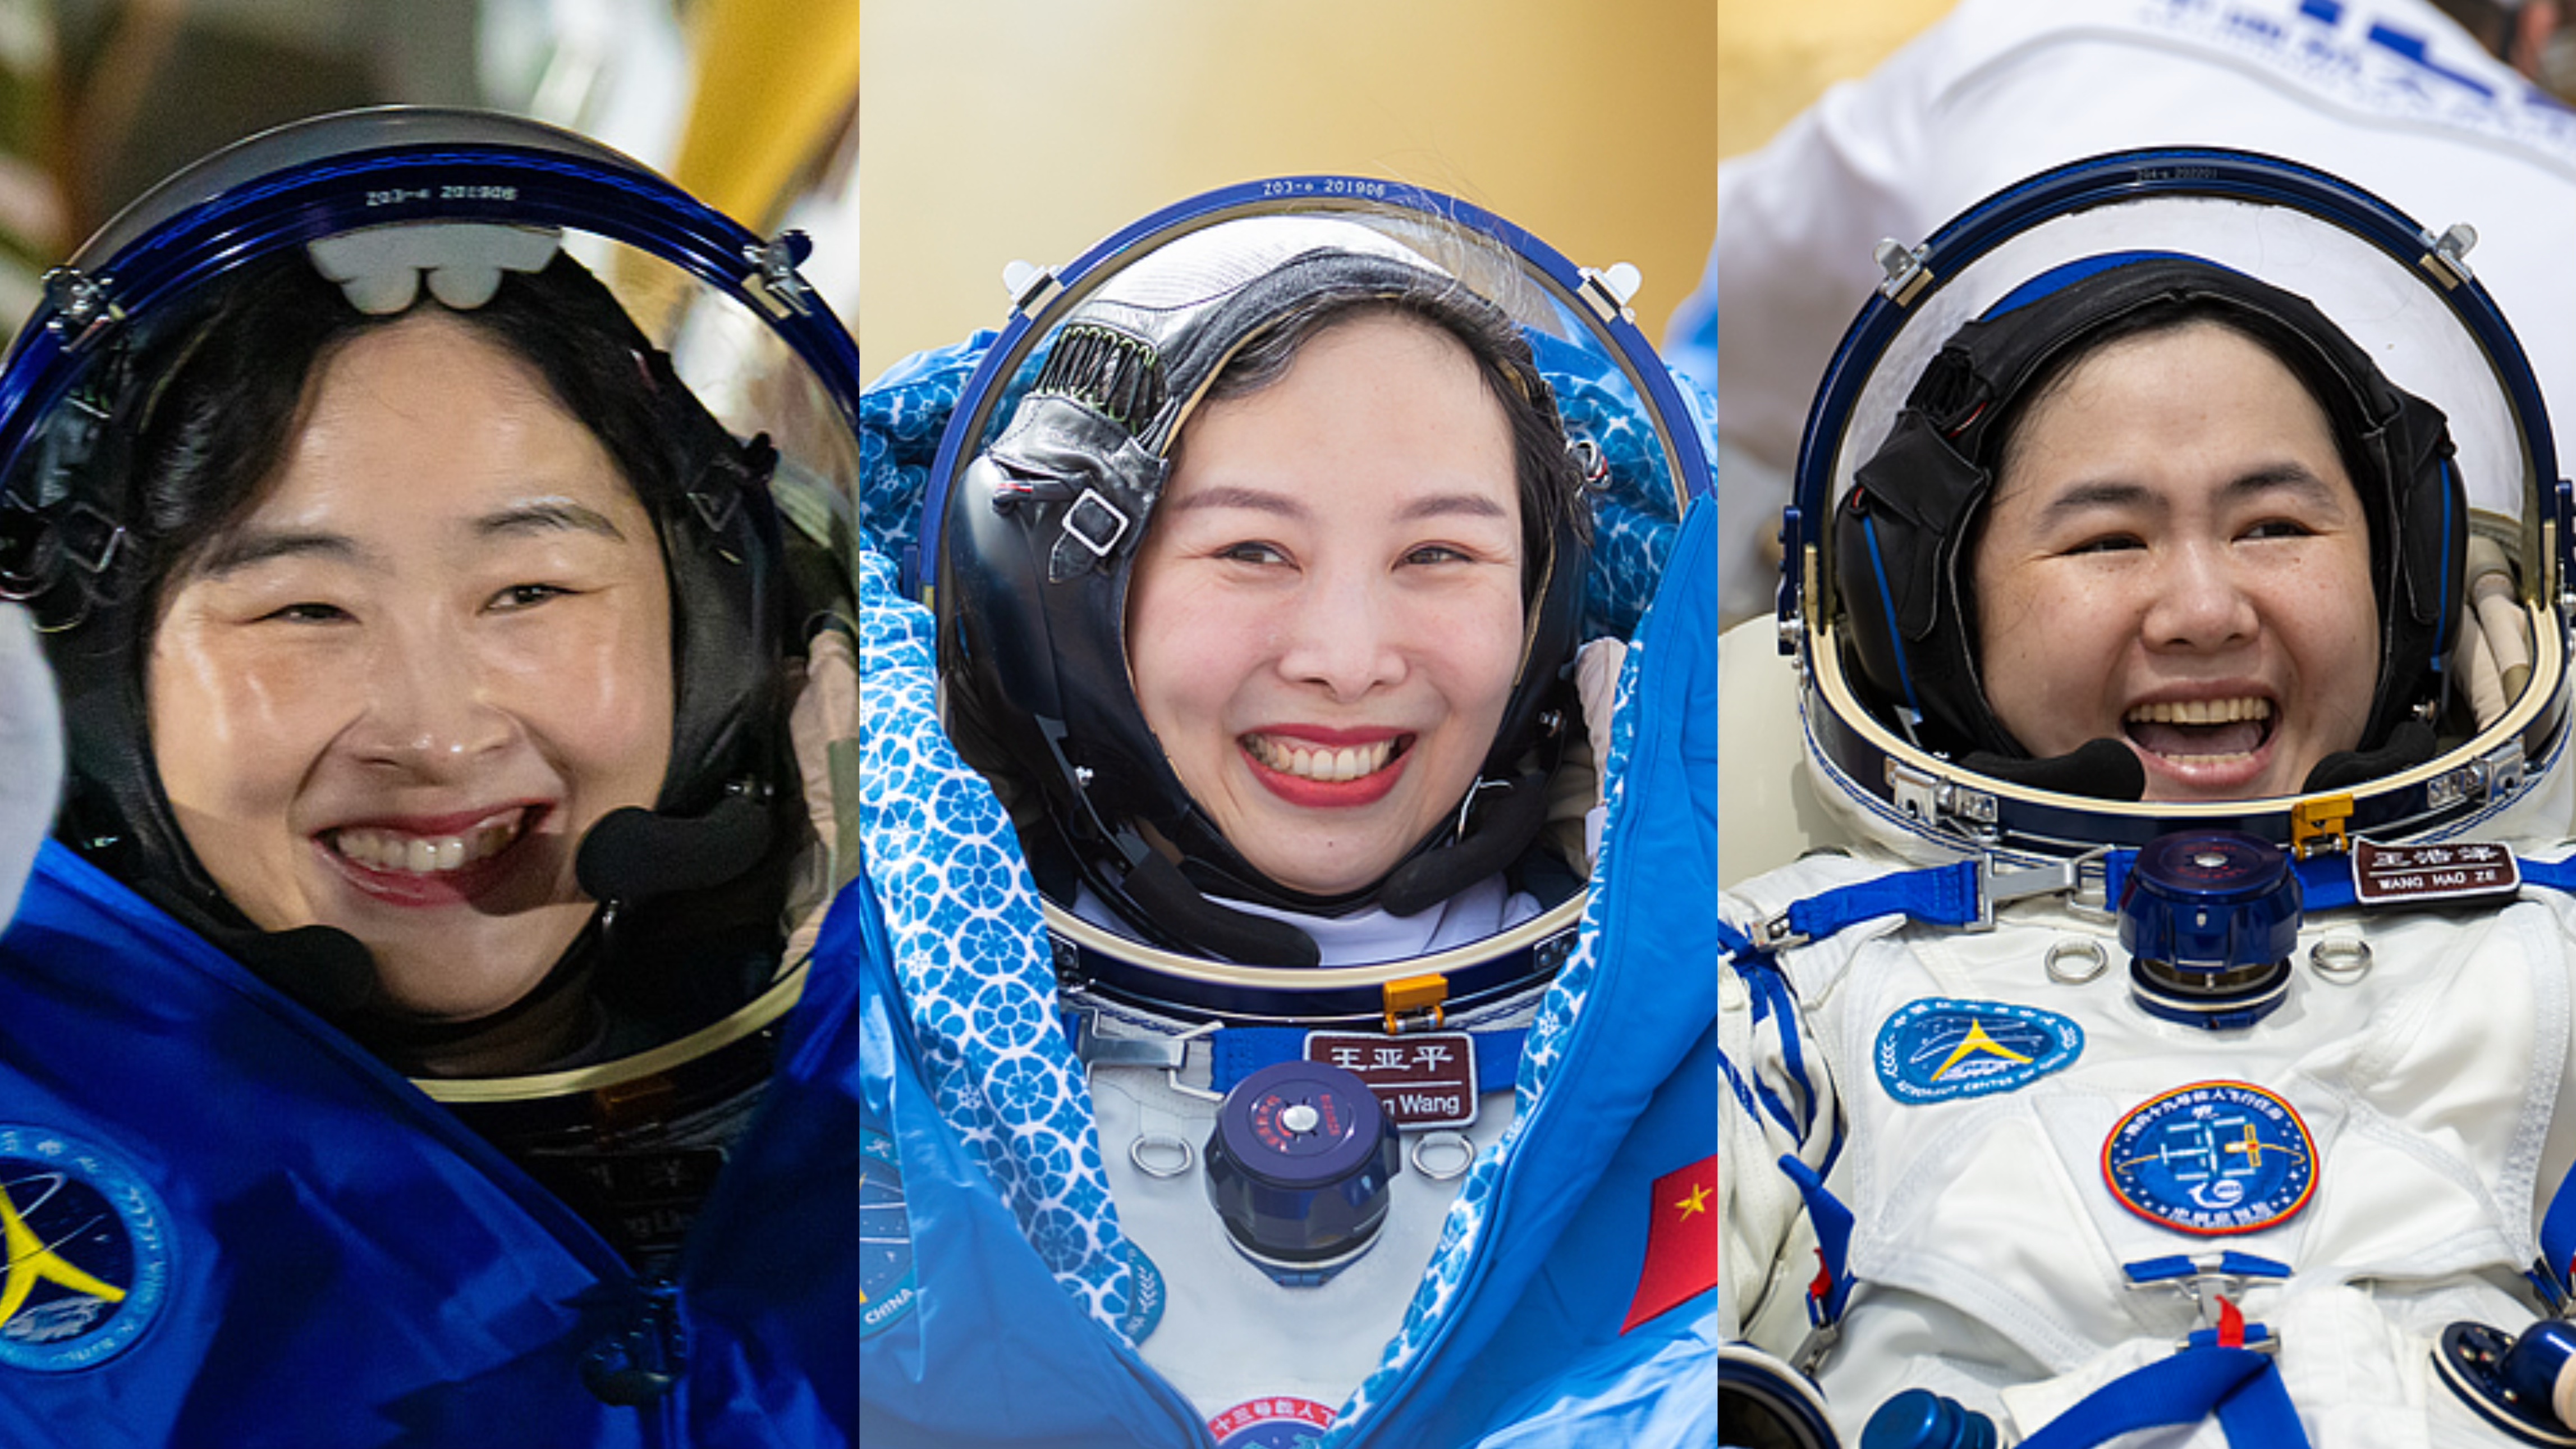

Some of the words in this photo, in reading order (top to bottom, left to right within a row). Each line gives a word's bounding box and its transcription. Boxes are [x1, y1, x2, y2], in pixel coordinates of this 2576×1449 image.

[2378, 876, 2424, 890] WANG
[2432, 871, 2466, 886] HAO
[2474, 869, 2496, 882] ZE
[1331, 1046, 1454, 1072] 王亚平
[1399, 1093, 1460, 1115] Wang
[864, 1288, 914, 1325] CHINA
